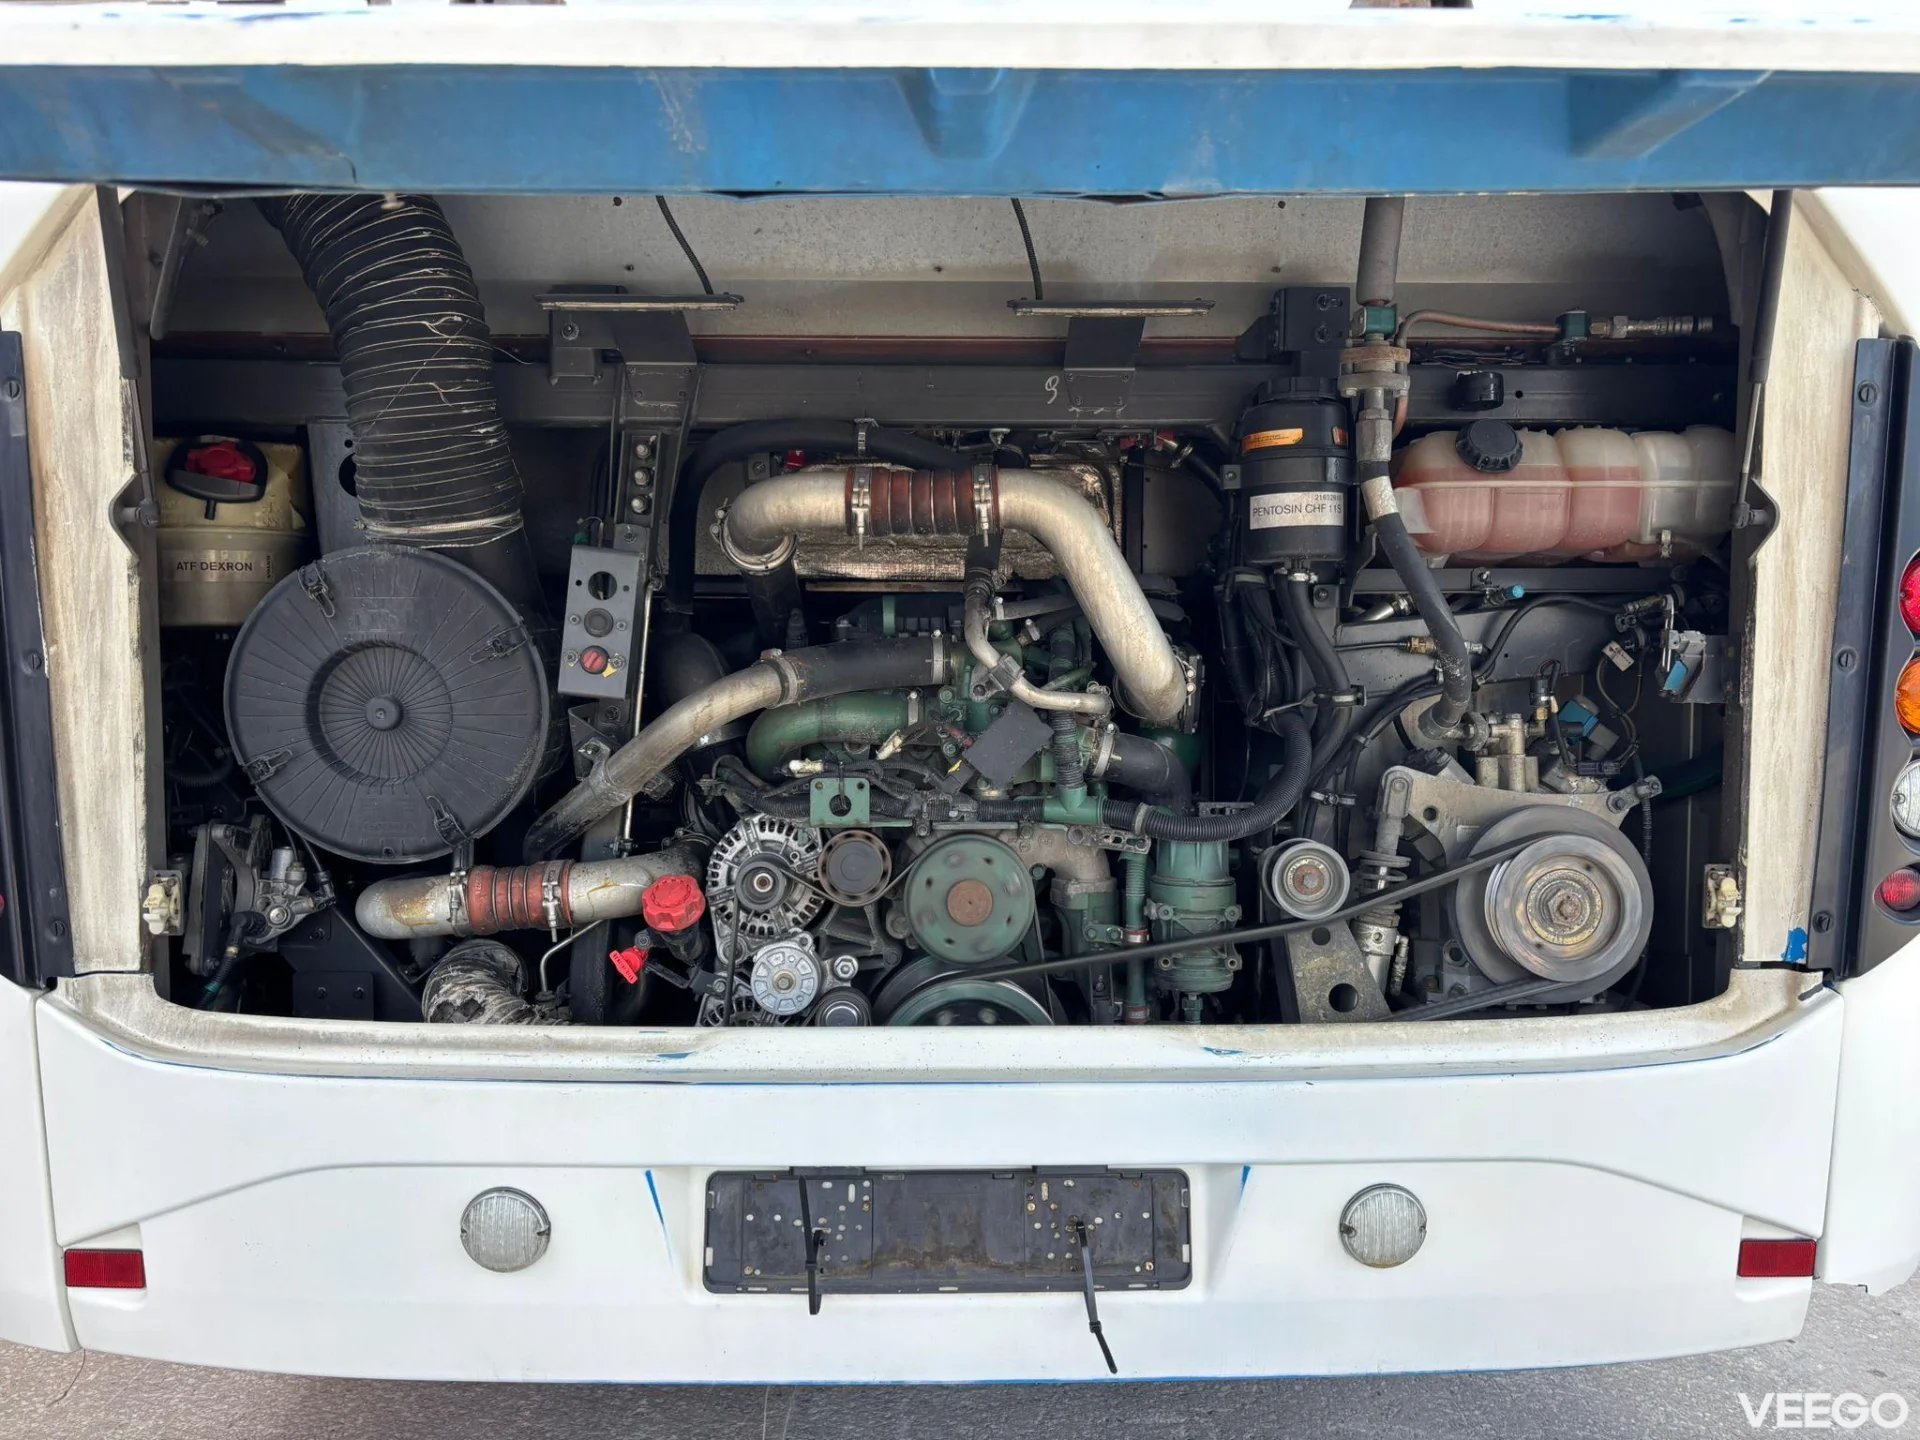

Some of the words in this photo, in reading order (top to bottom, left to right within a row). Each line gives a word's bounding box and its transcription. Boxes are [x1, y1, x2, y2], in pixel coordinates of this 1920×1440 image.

[1252, 504, 1302, 517] PENTOSIN
[1305, 503, 1326, 513] CHF
[176, 561, 197, 571] ATF
[200, 561, 253, 572] DEXRON
